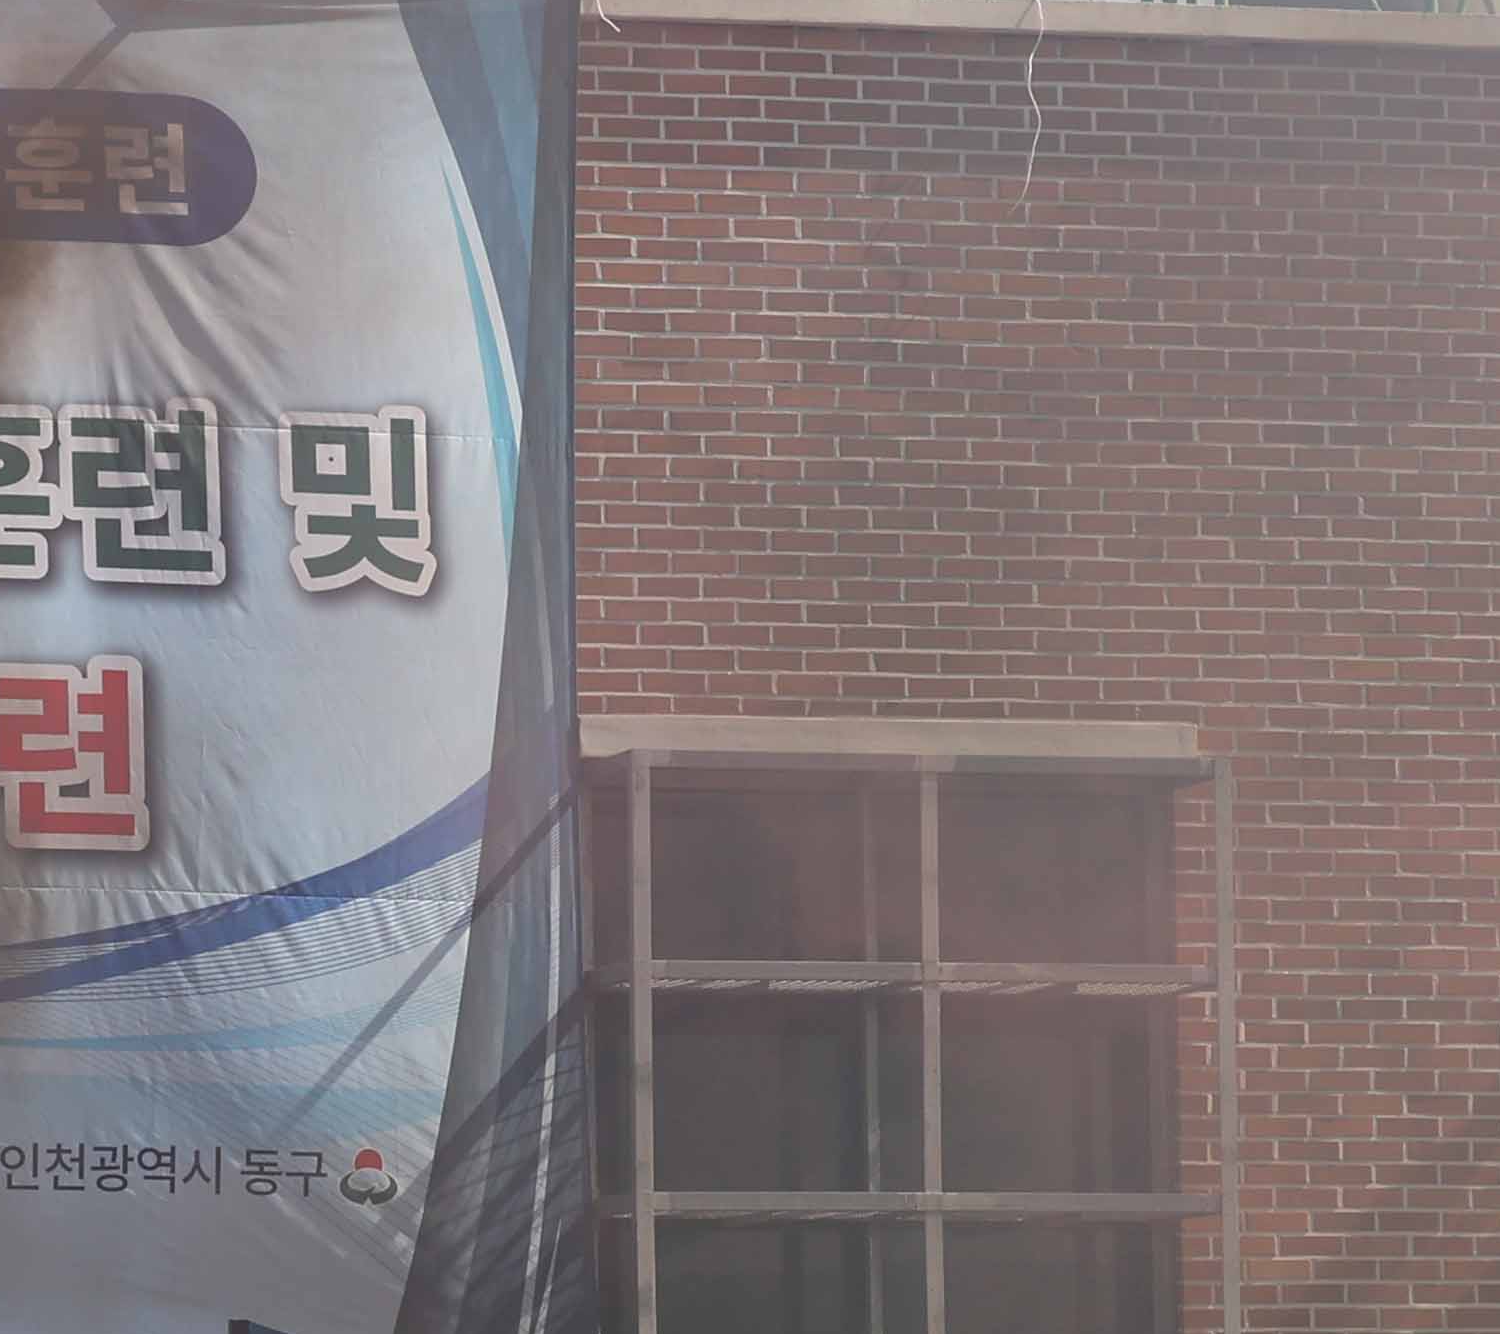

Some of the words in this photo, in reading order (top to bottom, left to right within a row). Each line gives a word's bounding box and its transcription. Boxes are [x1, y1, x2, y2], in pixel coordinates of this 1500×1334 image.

[288, 415, 428, 585] 및
[0, 1141, 222, 1195] 인천광역시
[239, 1147, 328, 1197] 동구
